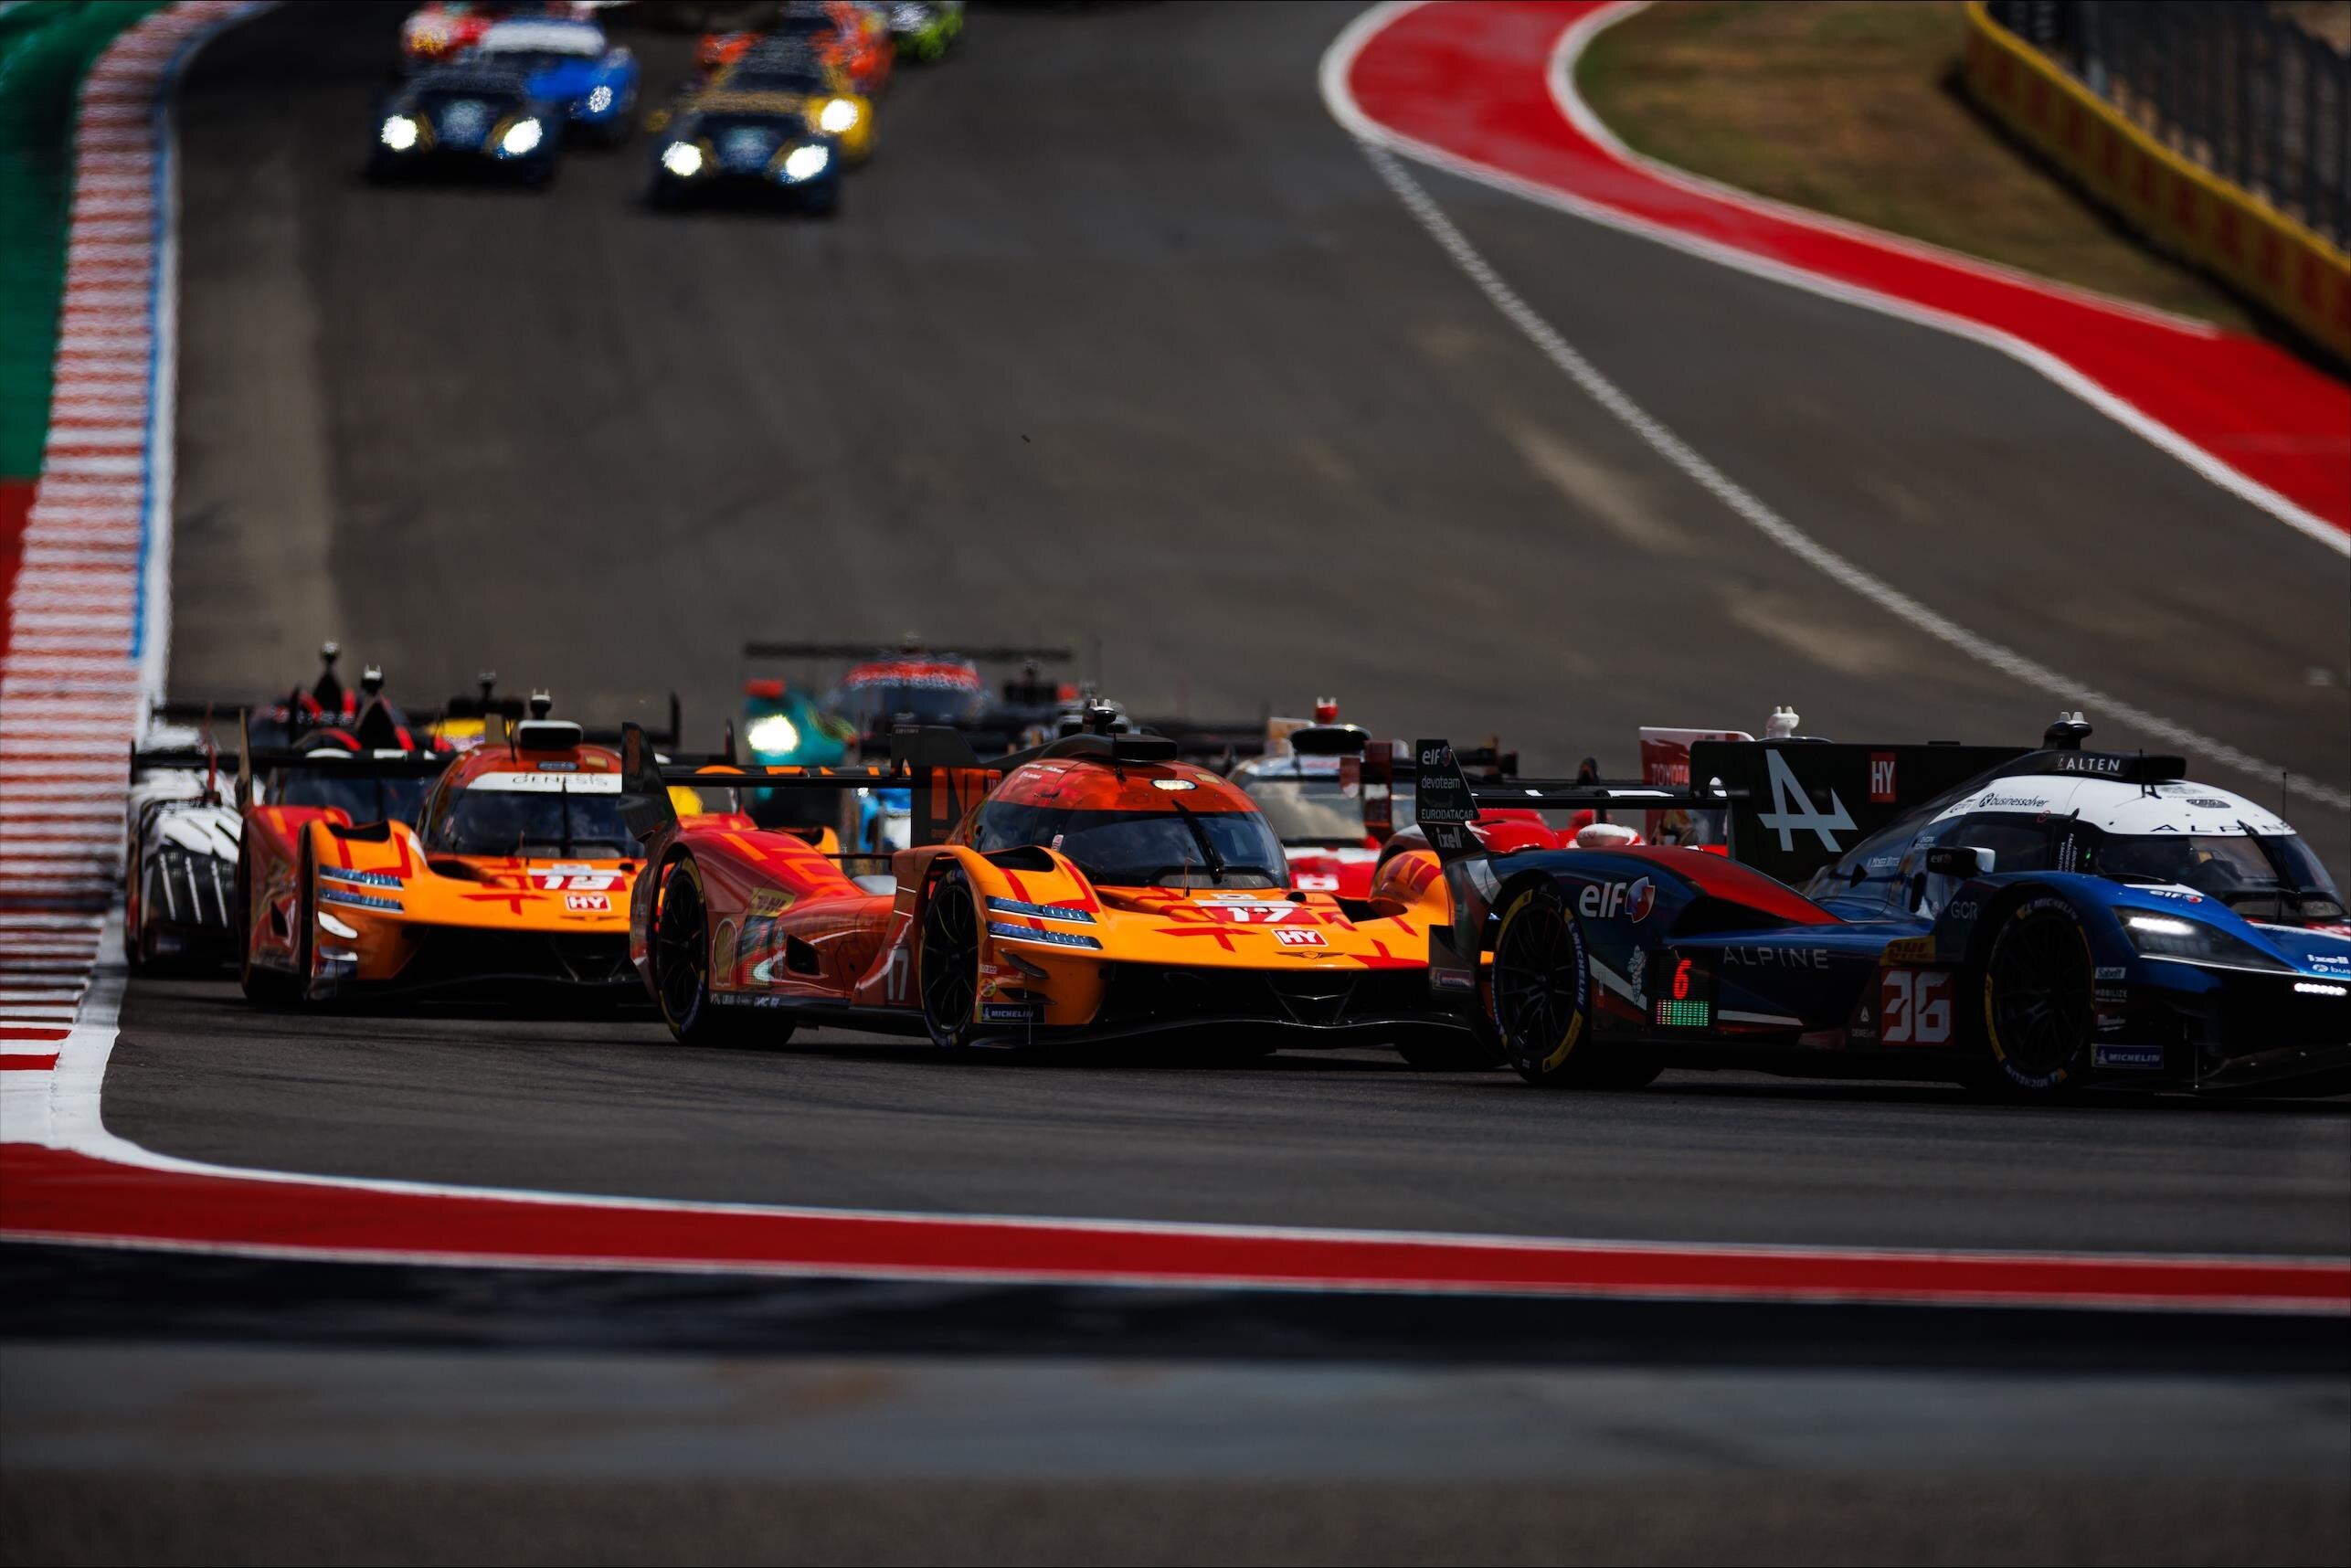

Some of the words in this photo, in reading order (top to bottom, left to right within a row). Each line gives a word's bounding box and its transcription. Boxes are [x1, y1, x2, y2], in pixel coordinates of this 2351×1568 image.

[1422, 747, 1441, 766] elf
[2066, 758, 2121, 772] ALTEN
[1421, 775, 1461, 790] devoteam
[1871, 760, 1896, 794] HY
[1989, 794, 2049, 808] businessolver
[1421, 808, 1474, 821] EURODATACAR
[1435, 826, 1463, 850] ixell
[567, 896, 607, 910] HY
[1579, 882, 1627, 918] elf
[2149, 890, 2185, 899] elf
[1226, 906, 1294, 923] 17
[1950, 901, 1979, 920] GCR
[1279, 929, 1318, 944] HY
[1722, 945, 1828, 970] ALPINE
[887, 948, 910, 1001] 17
[1572, 932, 1589, 1006] MICHELIN
[1672, 956, 1694, 1001] 6
[990, 1010, 1034, 1018] MICHELIN
[1882, 970, 1952, 1043] 36
[2107, 1053, 2161, 1063] MICHELIN
